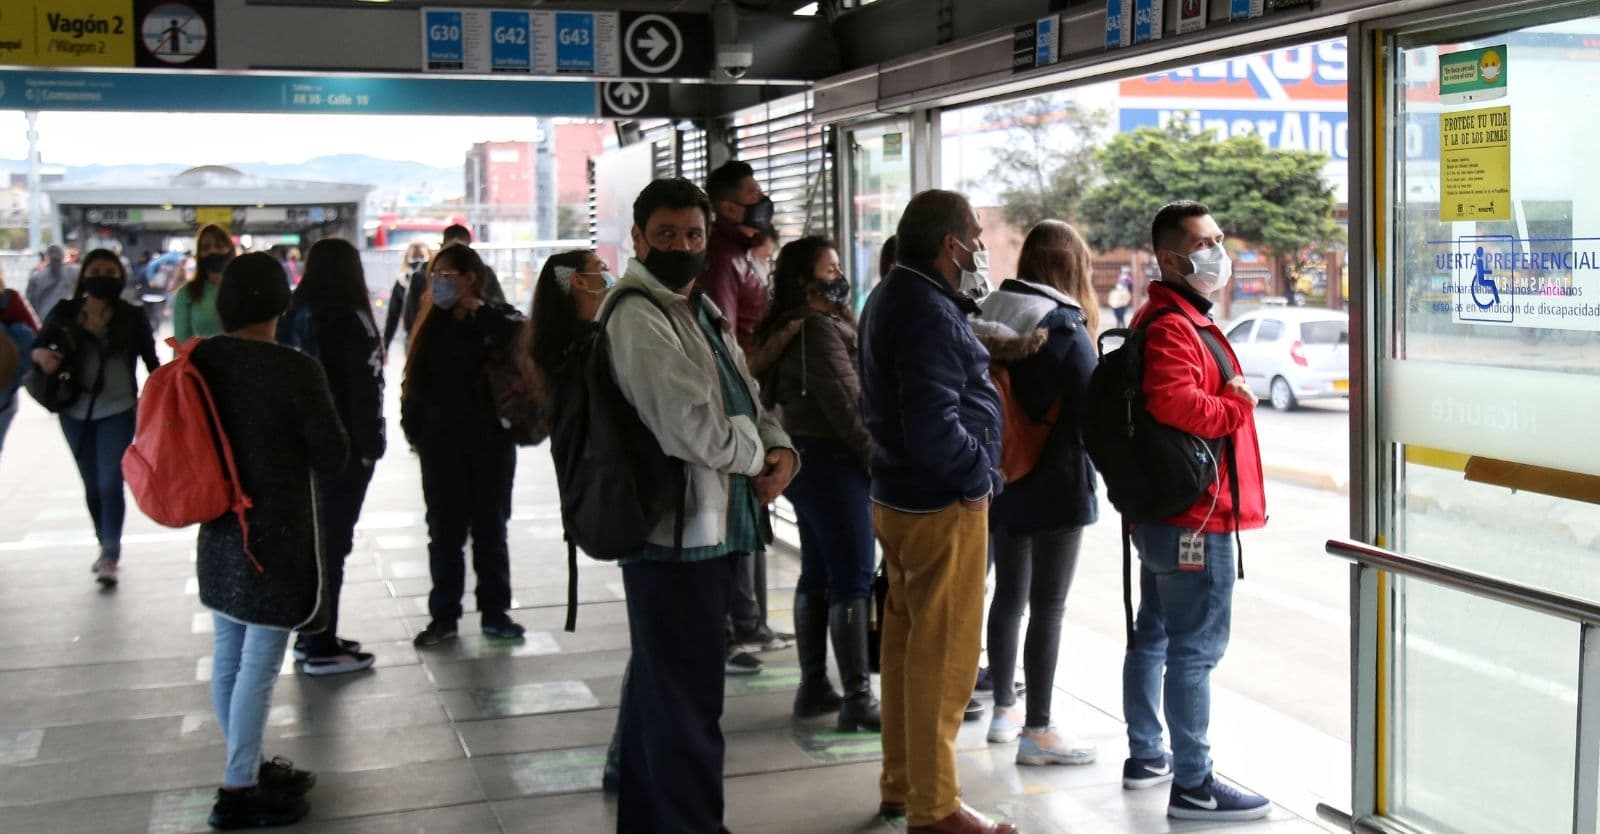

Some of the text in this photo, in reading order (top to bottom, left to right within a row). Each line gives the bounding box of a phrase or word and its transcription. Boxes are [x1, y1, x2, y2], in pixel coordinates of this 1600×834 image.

[47, 12, 125, 38] Vagón 2
[430, 24, 460, 42] G30
[494, 26, 526, 45] G42
[559, 28, 590, 46] G43
[1444, 112, 1507, 131] PROTEGE TU VIDA
[1444, 128, 1508, 146] Y LA DE LOS DEMÁS
[1485, 251, 1600, 270] PREFERENCIAL
[1539, 283, 1583, 297] Ancianos
[1523, 301, 1535, 315] de
[1537, 302, 1600, 319] discapacidad
